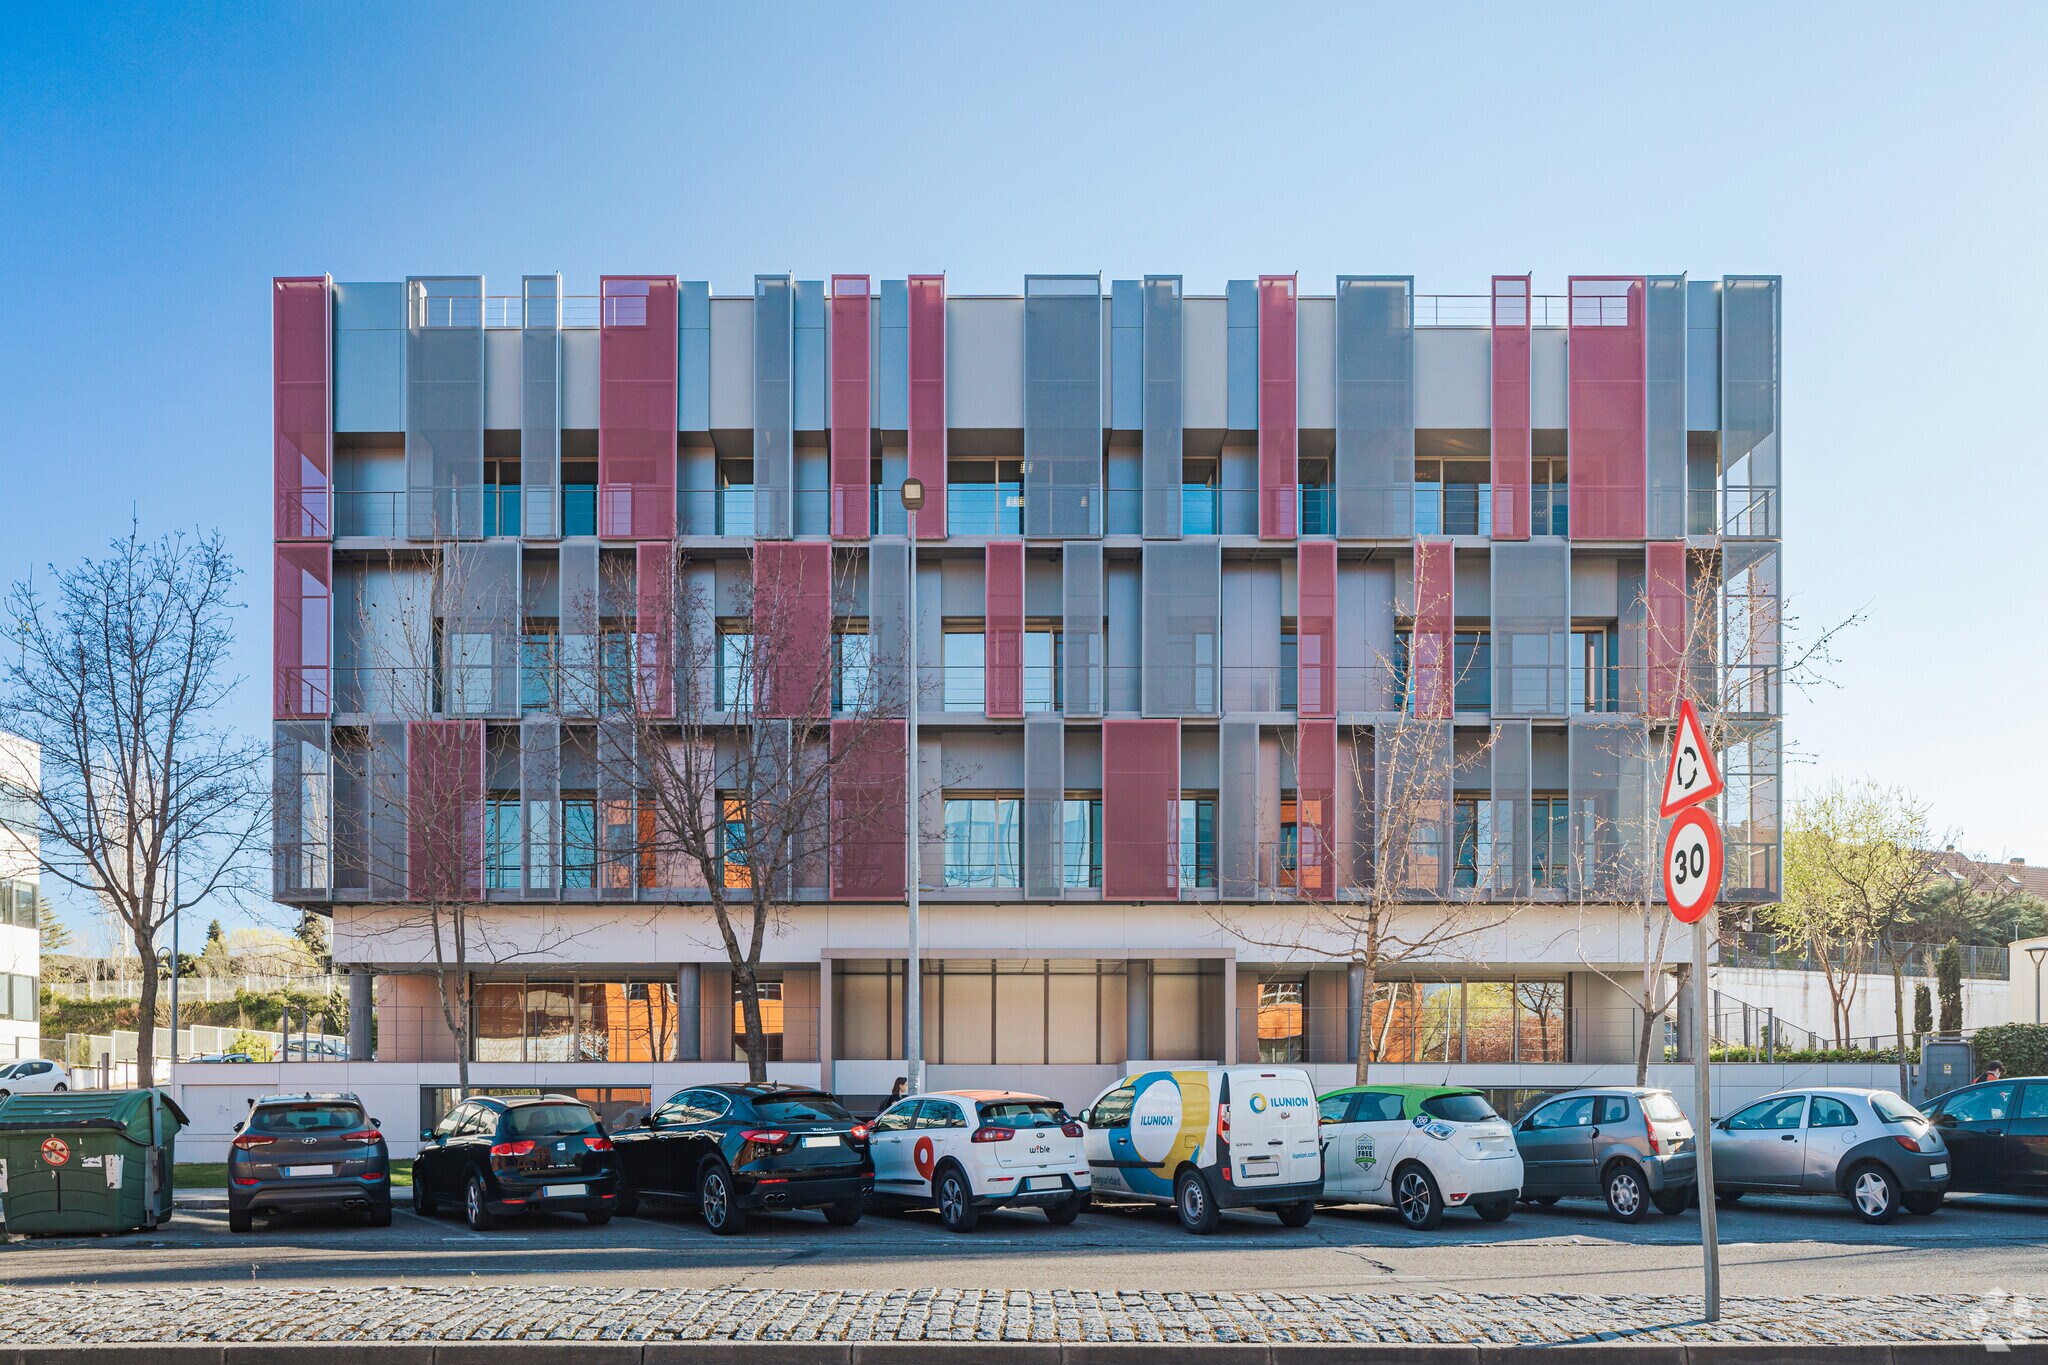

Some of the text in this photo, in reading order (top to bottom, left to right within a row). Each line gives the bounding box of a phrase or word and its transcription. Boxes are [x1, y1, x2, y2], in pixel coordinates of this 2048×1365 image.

[1674, 843, 1705, 885] 30
[1270, 1097, 1309, 1107] ILUNION
[1140, 1115, 1174, 1126] ILUNION
[1029, 1145, 1050, 1154] wible
[1358, 1150, 1373, 1158] FREE
[1091, 1174, 1121, 1186] Seguridad
